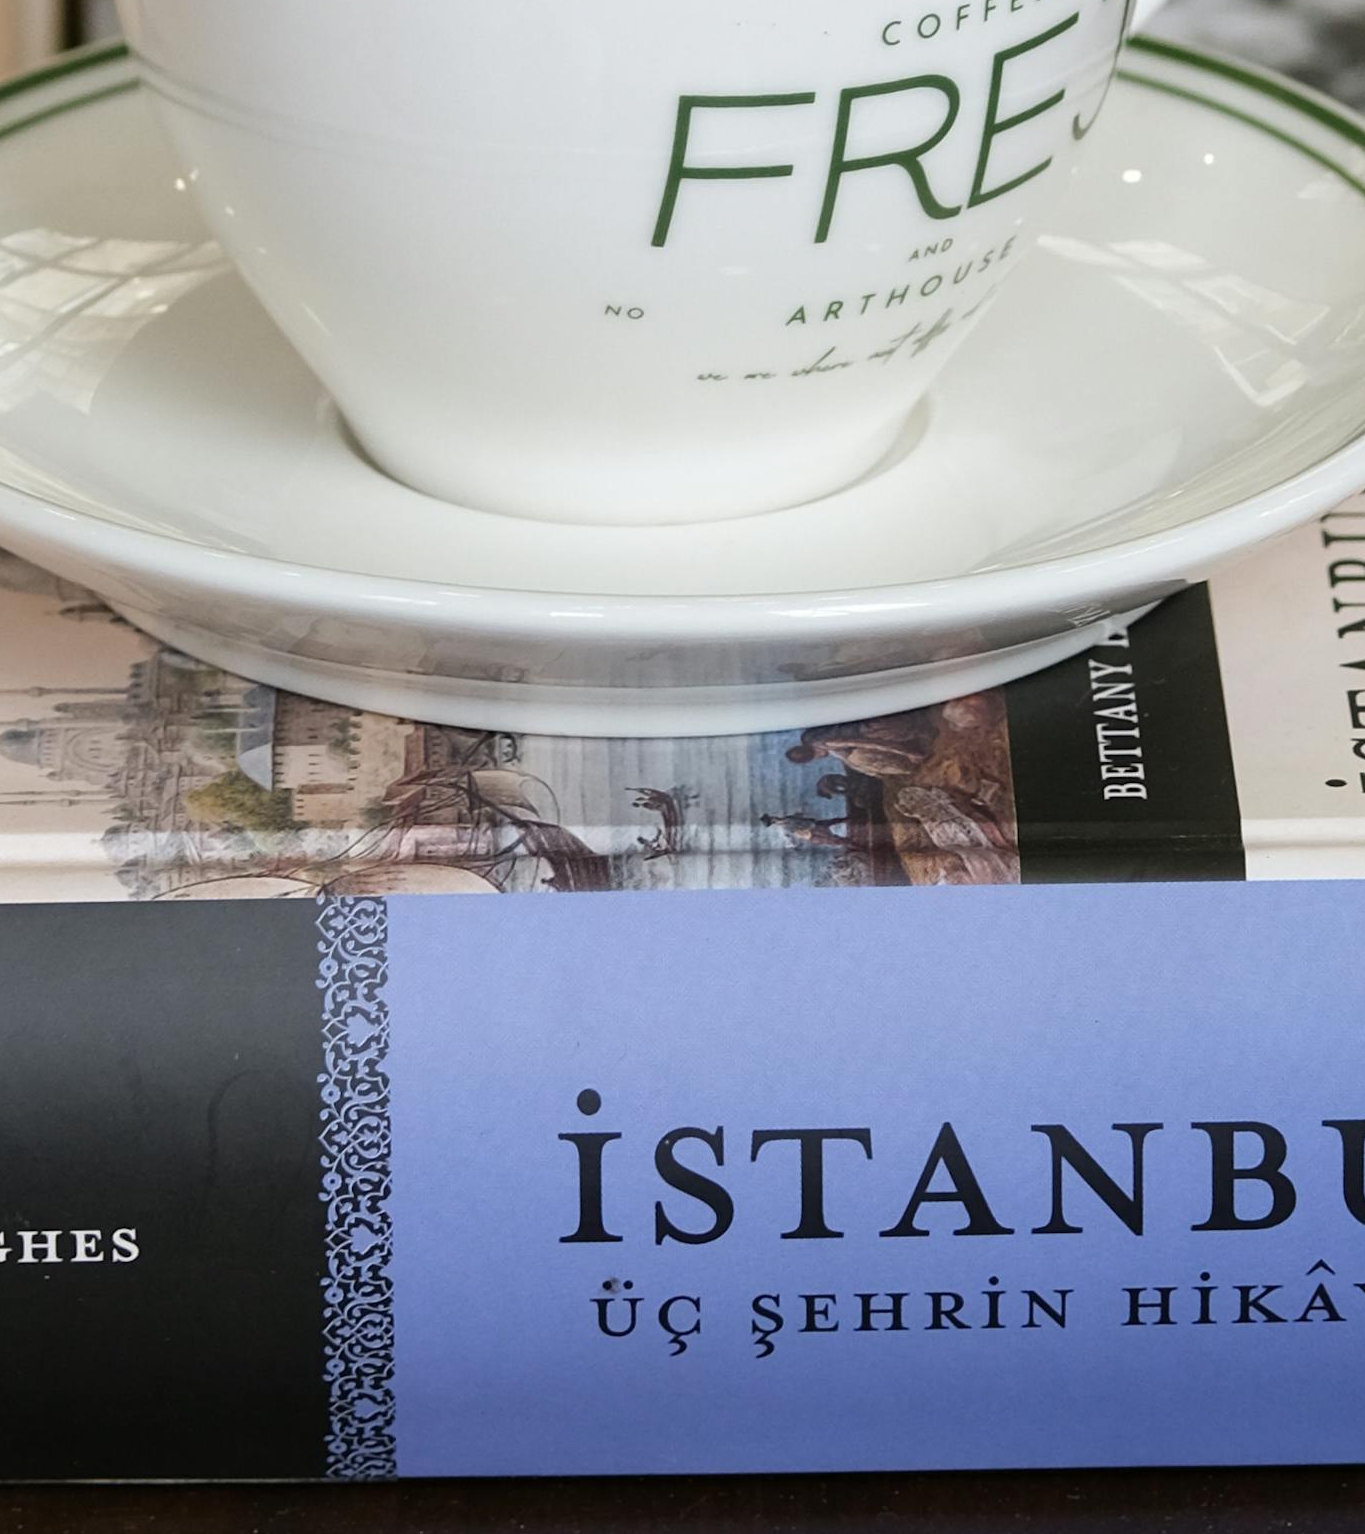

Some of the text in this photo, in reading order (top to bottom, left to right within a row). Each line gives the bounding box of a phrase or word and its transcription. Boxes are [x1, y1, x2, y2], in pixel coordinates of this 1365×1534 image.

[785, 236, 1017, 327] ARTHOUSE
[908, 237, 954, 262] AND
[604, 304, 644, 320] NO
[1088, 658, 1149, 801] BETTANY
[592, 1278, 705, 1357] ÜÇ
[751, 1275, 1077, 1360] ŞEHRİN
